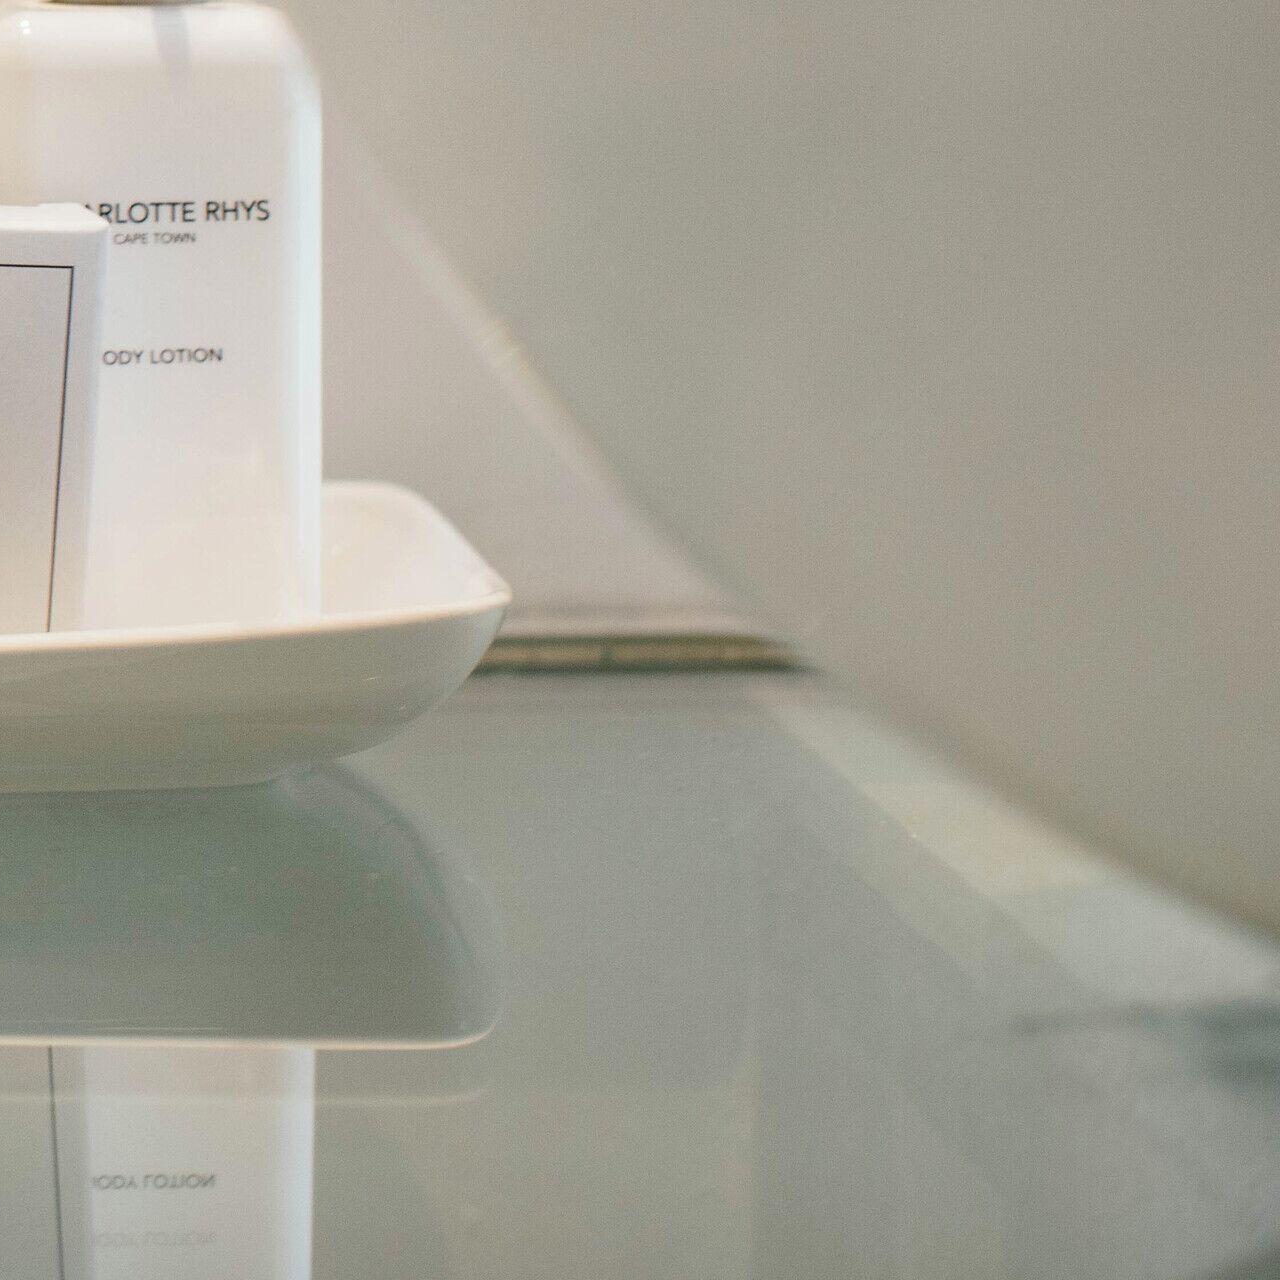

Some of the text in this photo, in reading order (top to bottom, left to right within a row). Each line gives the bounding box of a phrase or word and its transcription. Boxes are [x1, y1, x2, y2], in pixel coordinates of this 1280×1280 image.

[84, 200, 270, 224] RLOTTE RHYS
[113, 232, 148, 245] CAPE
[102, 347, 223, 366] ODY LOTION
